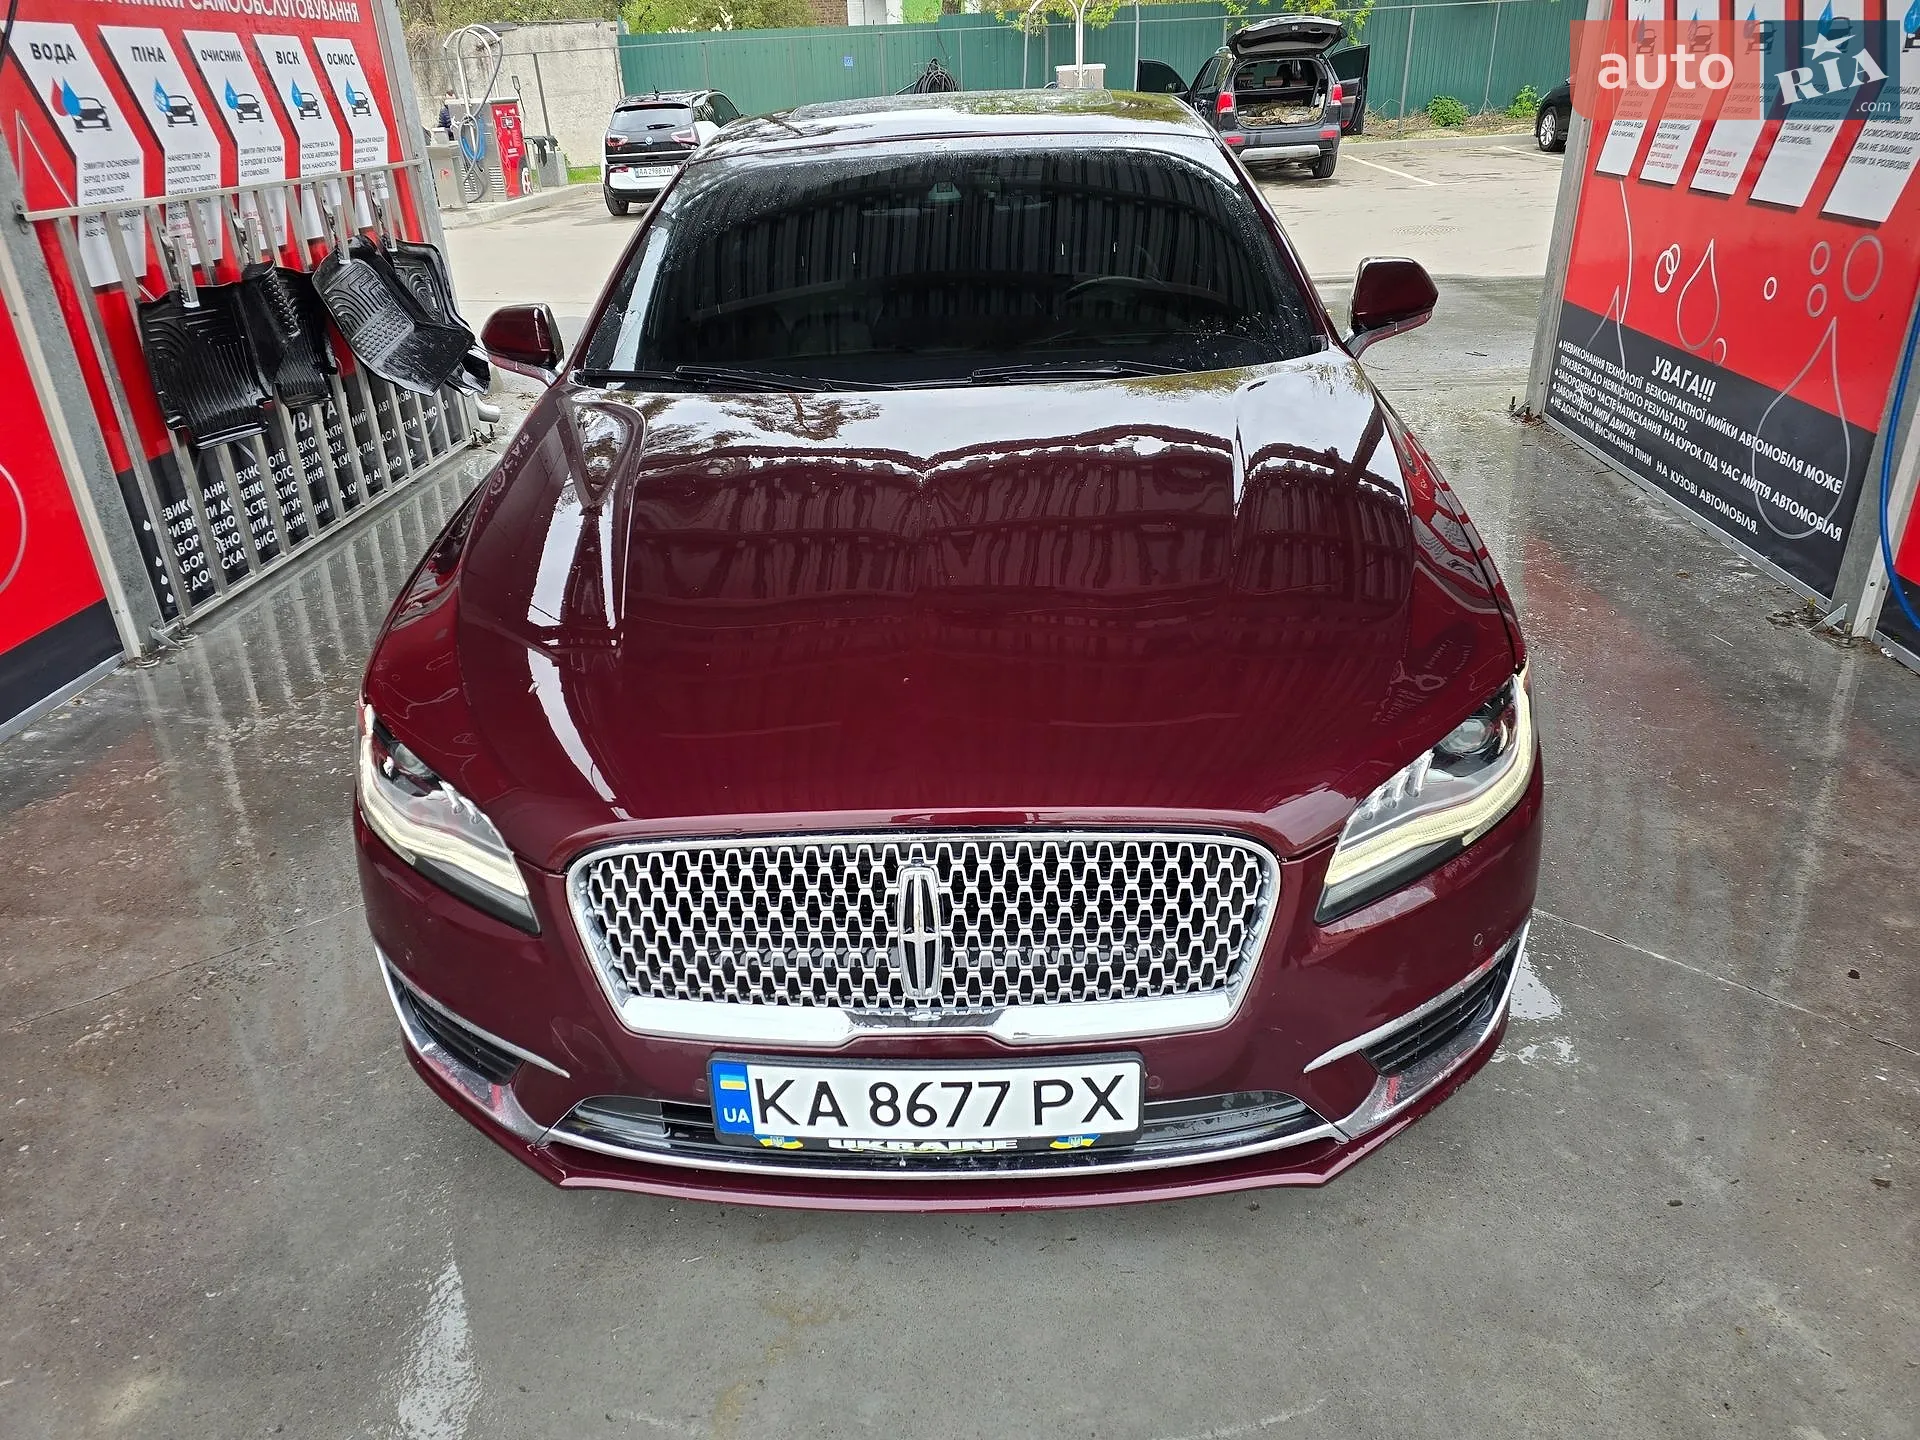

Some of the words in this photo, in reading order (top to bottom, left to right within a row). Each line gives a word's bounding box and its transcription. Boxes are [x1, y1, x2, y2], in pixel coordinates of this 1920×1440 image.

[30, 42, 77, 65] ВОДА
[131, 46, 167, 63] ПІНА
[200, 50, 243, 63] ОЧИСНИК
[275, 51, 301, 65] ВІСК
[327, 53, 356, 66] ОСМОС
[1560, 355, 1592, 380] ПРИЗВЕСТИ
[1591, 371, 1603, 385] ДО
[1602, 378, 1644, 407] НЕЯКІСНОГО
[1644, 400, 1688, 433] РЕЗУЛЬТАТУ.
[1651, 356, 1717, 402] УВАГА!!!
[1556, 383, 1592, 412] ЗАБОРОНЕНО
[1592, 405, 1610, 423] МИТИ
[1609, 416, 1636, 440] ДВИГУН.
[1563, 340, 1605, 369] НЕВИКОНАННЯ
[1604, 361, 1644, 389] ТЕХНОЛОГІЇ
[1645, 382, 1707, 422] БЕЗКОНТАКТНОЇ
[1705, 413, 1739, 439] МИЙКИ
[1738, 431, 1803, 474] АВТОМОБІЛЯ
[1804, 464, 1842, 494] МОЖЕ
[1554, 396, 1561, 408] НЕ
[1560, 402, 1595, 430] ДОПУСКАТИ
[1594, 423, 1634, 455] ВИСИХАННЯ
[1635, 447, 1652, 466] ПІНИ
[1656, 460, 1668, 477] НА
[1670, 470, 1698, 496] КУЗОВІ
[1699, 489, 1758, 535] АВТОМОБІЛЯ.
[1558, 369, 1596, 398] ЗАБОРОНЕНО
[1596, 390, 1616, 410] ЧАСТЕ
[1616, 402, 1662, 436] НАТИСКАННЯ
[1663, 427, 1675, 445] НА
[1674, 436, 1703, 460] КУРОК
[1702, 450, 1719, 471] ПІД
[1720, 460, 1741, 481] ЧАС
[1740, 473, 1771, 499] МИТТЯ
[1771, 491, 1842, 541] АВТОМОБІЛЯ
[723, 1107, 751, 1124] UA
[755, 1078, 848, 1127] KA
[868, 1080, 1011, 1128] 8677
[1033, 1074, 1125, 1127] PX
[828, 1138, 1017, 1153] UKRAINE
